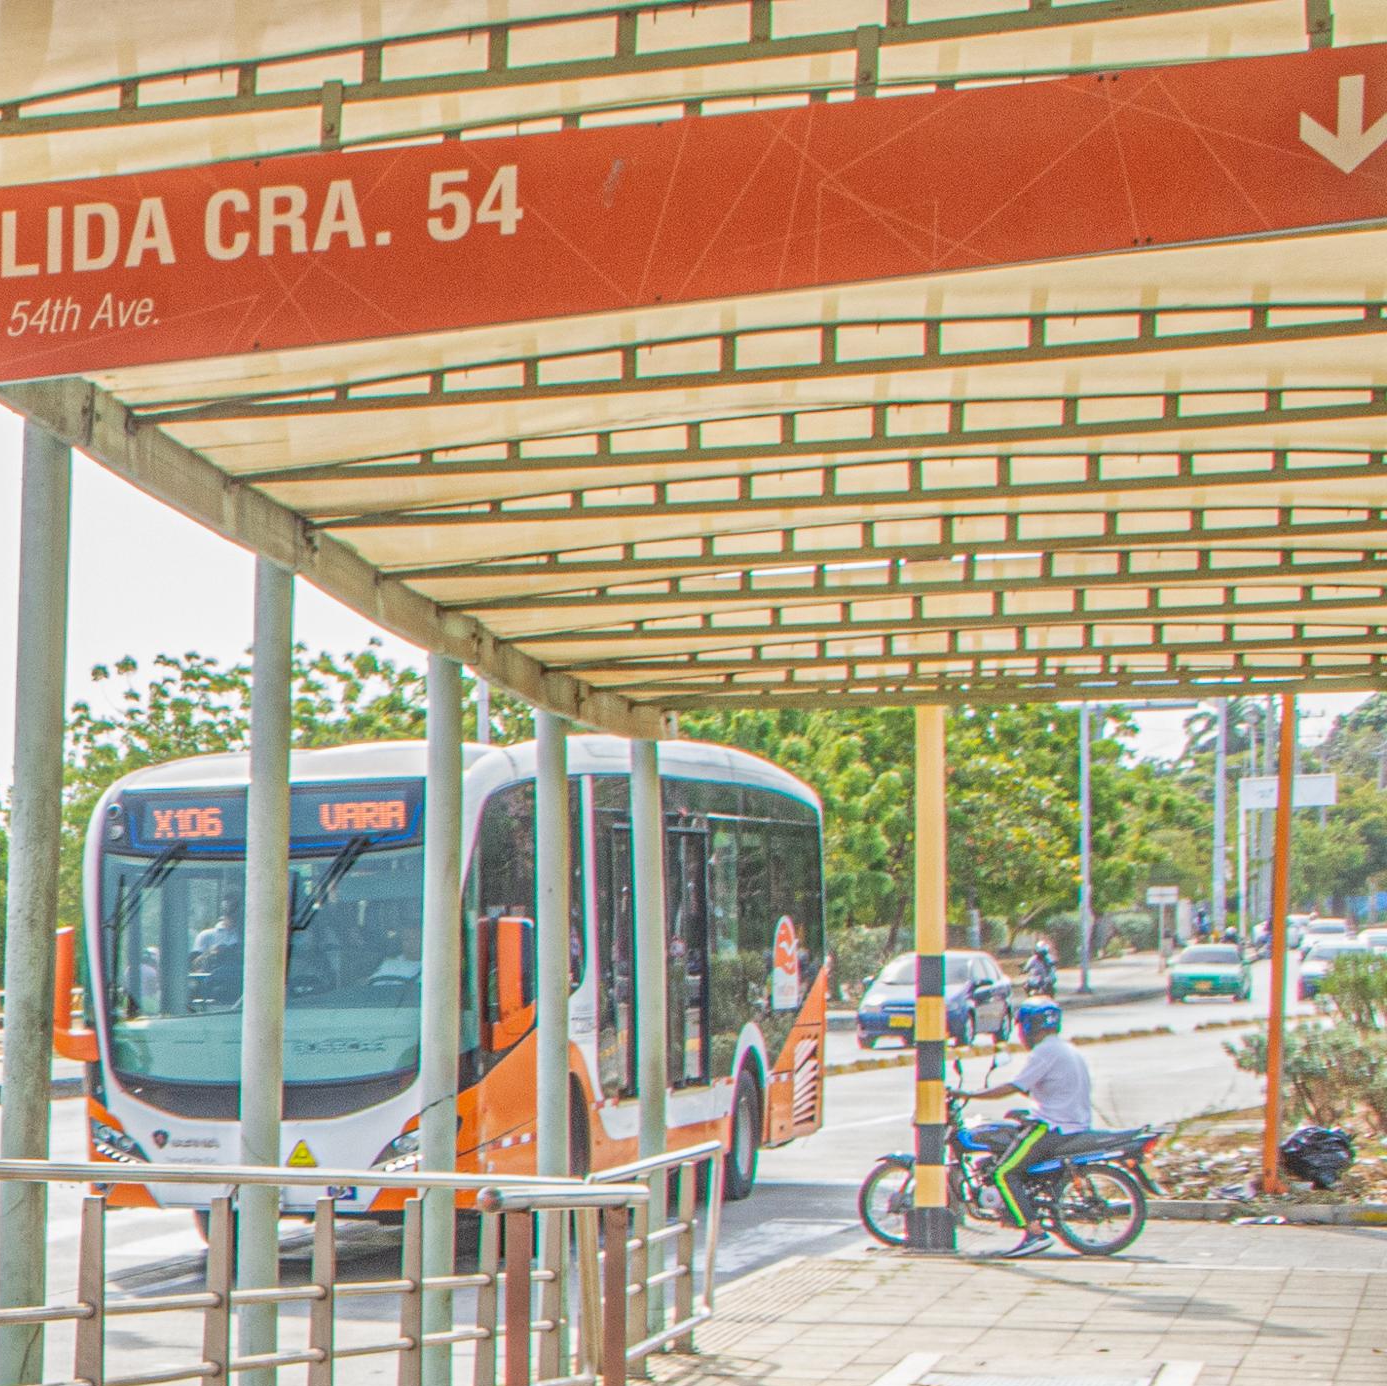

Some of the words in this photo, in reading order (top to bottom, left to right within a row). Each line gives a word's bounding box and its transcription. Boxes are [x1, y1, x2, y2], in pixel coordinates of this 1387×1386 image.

[204, 179, 393, 261] CRA.
[428, 165, 524, 241] 54
[7, 298, 82, 337] 54th
[89, 293, 160, 330] Ave.
[153, 807, 224, 839] X106
